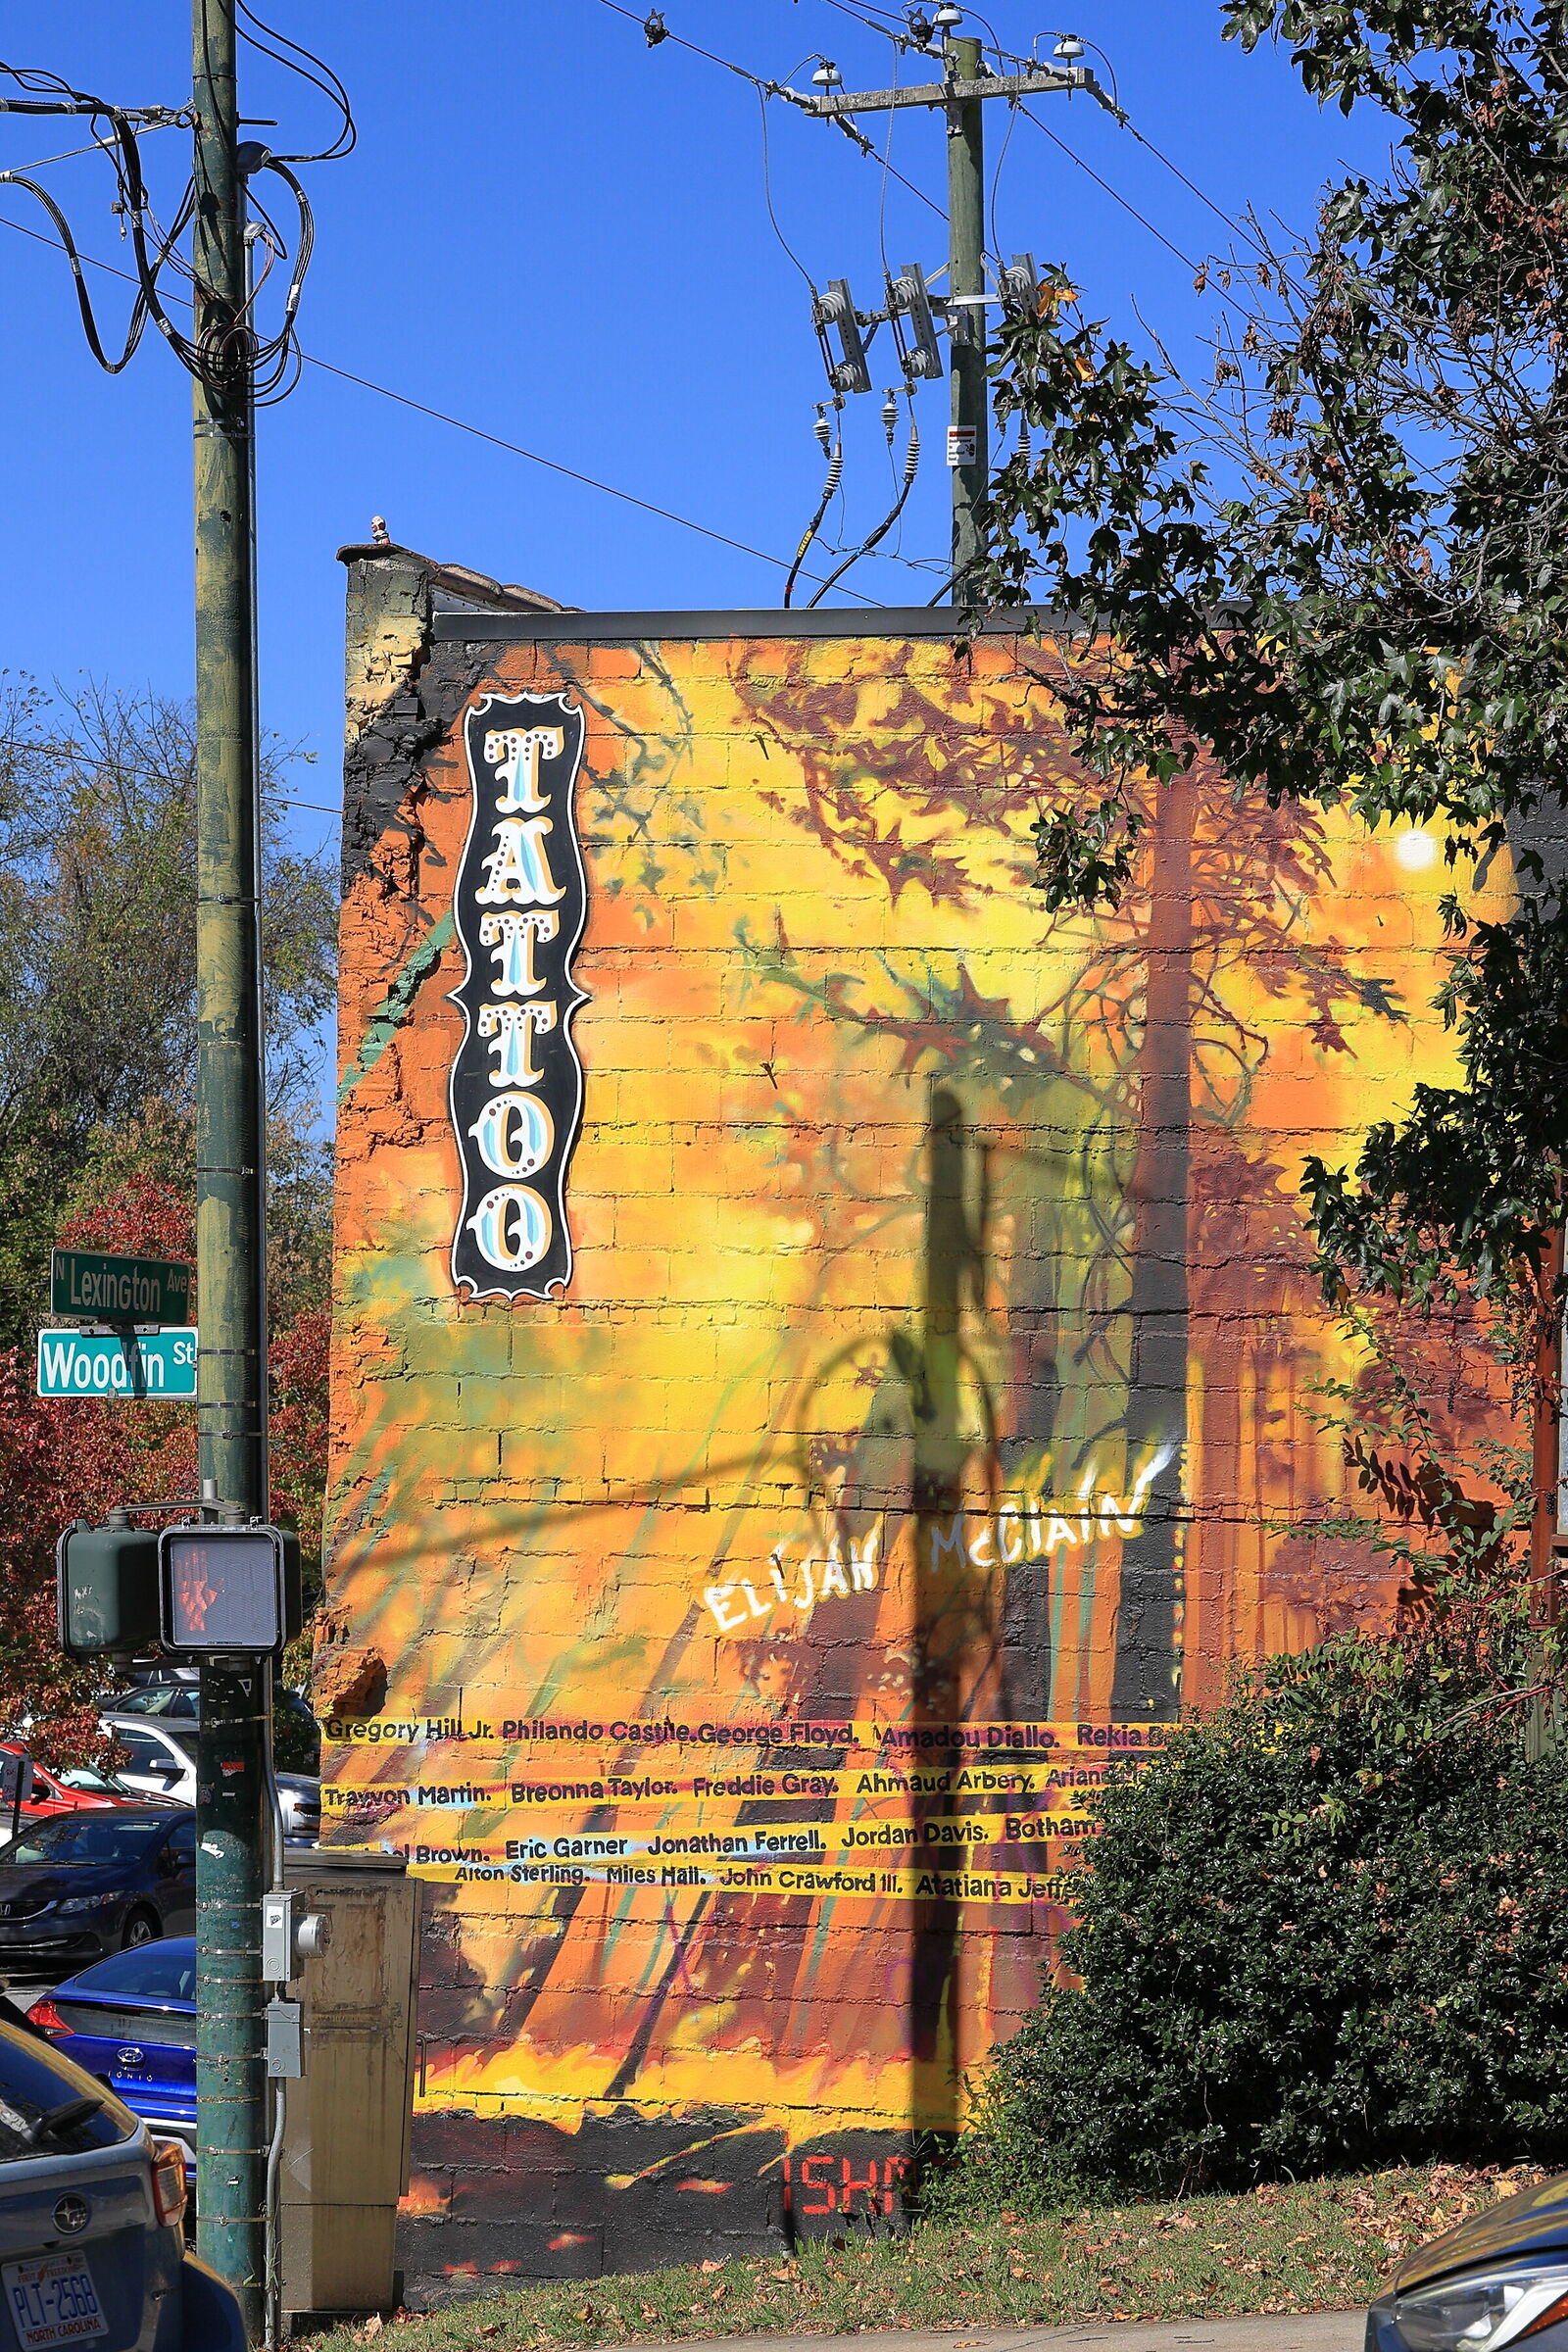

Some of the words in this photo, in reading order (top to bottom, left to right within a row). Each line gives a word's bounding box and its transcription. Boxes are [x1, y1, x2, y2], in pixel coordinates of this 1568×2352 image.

[466, 725, 564, 1274] TATTOO
[55, 1256, 65, 1281] N
[70, 1258, 161, 1313] Lexington
[167, 1269, 187, 1294] Ave
[43, 1342, 165, 1389] Woodfin
[173, 1341, 193, 1365] St
[326, 1718, 419, 1743] Gregory
[425, 1718, 463, 1740] Hill
[468, 1720, 494, 1740] Jr.
[502, 1720, 604, 1740] Philando
[698, 1723, 783, 1747] George
[790, 1723, 859, 1748] Floyd.
[881, 1725, 979, 1747] Amadou
[988, 1726, 1060, 1748] Diallo.
[1077, 1724, 1143, 1747] Rekia
[417, 1781, 492, 1805] Martin.
[512, 1781, 604, 1803] Breonna
[608, 1777, 678, 1800] Taylor.
[694, 1775, 775, 1797] Freddie
[781, 1773, 839, 1797] Gray.
[857, 1770, 950, 1793] Ahmaud
[956, 1770, 1035, 1792] Arbery.
[416, 1844, 490, 1864] Brown.
[506, 1838, 547, 1859] Eric
[553, 1837, 628, 1857] Garner
[647, 1834, 747, 1856] Jonathan
[756, 1829, 826, 1851] Ferrell.
[841, 1824, 917, 1847] Jordan
[924, 1820, 989, 1843] Davis.
[1005, 1817, 1097, 1840] Botham
[455, 1866, 505, 1882] Alton
[510, 1865, 591, 1886] Sterling.
[607, 1865, 656, 1884] Miles
[719, 1868, 771, 1887] John
[779, 1871, 875, 1892] Crawford
[915, 1874, 1011, 1897] Atatiana
[12, 2274, 98, 2328] PLT-2568
[26, 2327, 56, 2343] NORTH
[57, 2318, 102, 2338] CAROLINA
